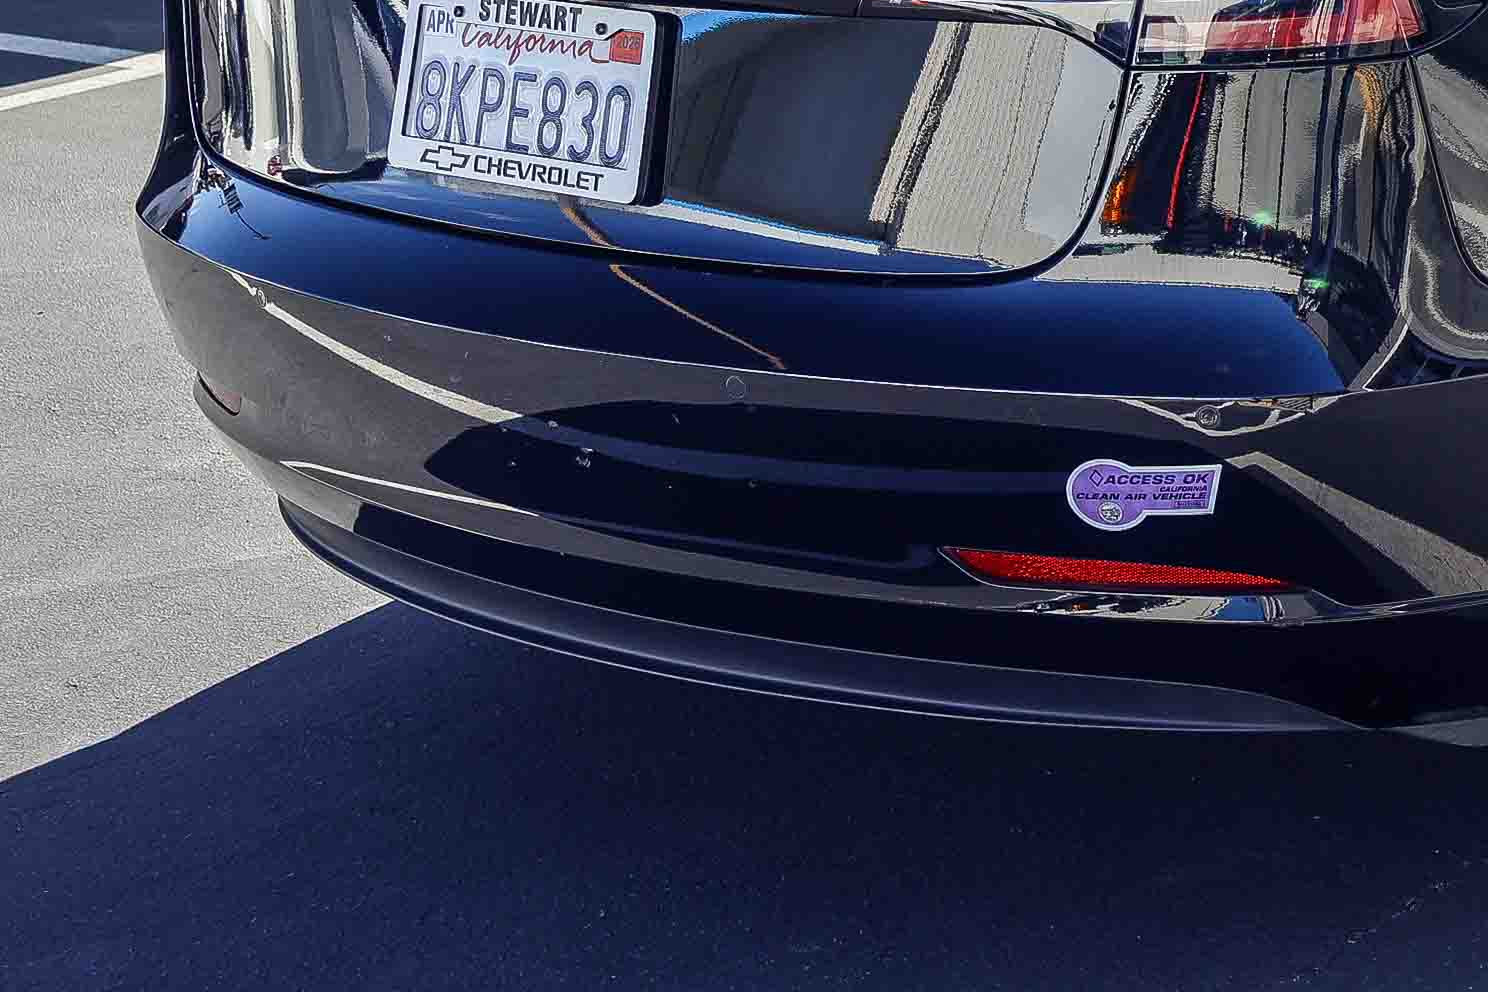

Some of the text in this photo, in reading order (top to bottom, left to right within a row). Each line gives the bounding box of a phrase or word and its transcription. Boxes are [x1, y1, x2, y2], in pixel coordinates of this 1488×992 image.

[426, 9, 455, 34] APR
[462, 23, 610, 65] California
[415, 60, 632, 167] 8KPE830
[473, 154, 604, 192] CHEVROLET
[1076, 492, 1207, 500] CLEAN AIR VEHICLE
[1104, 473, 1209, 485] ACCESS OK
